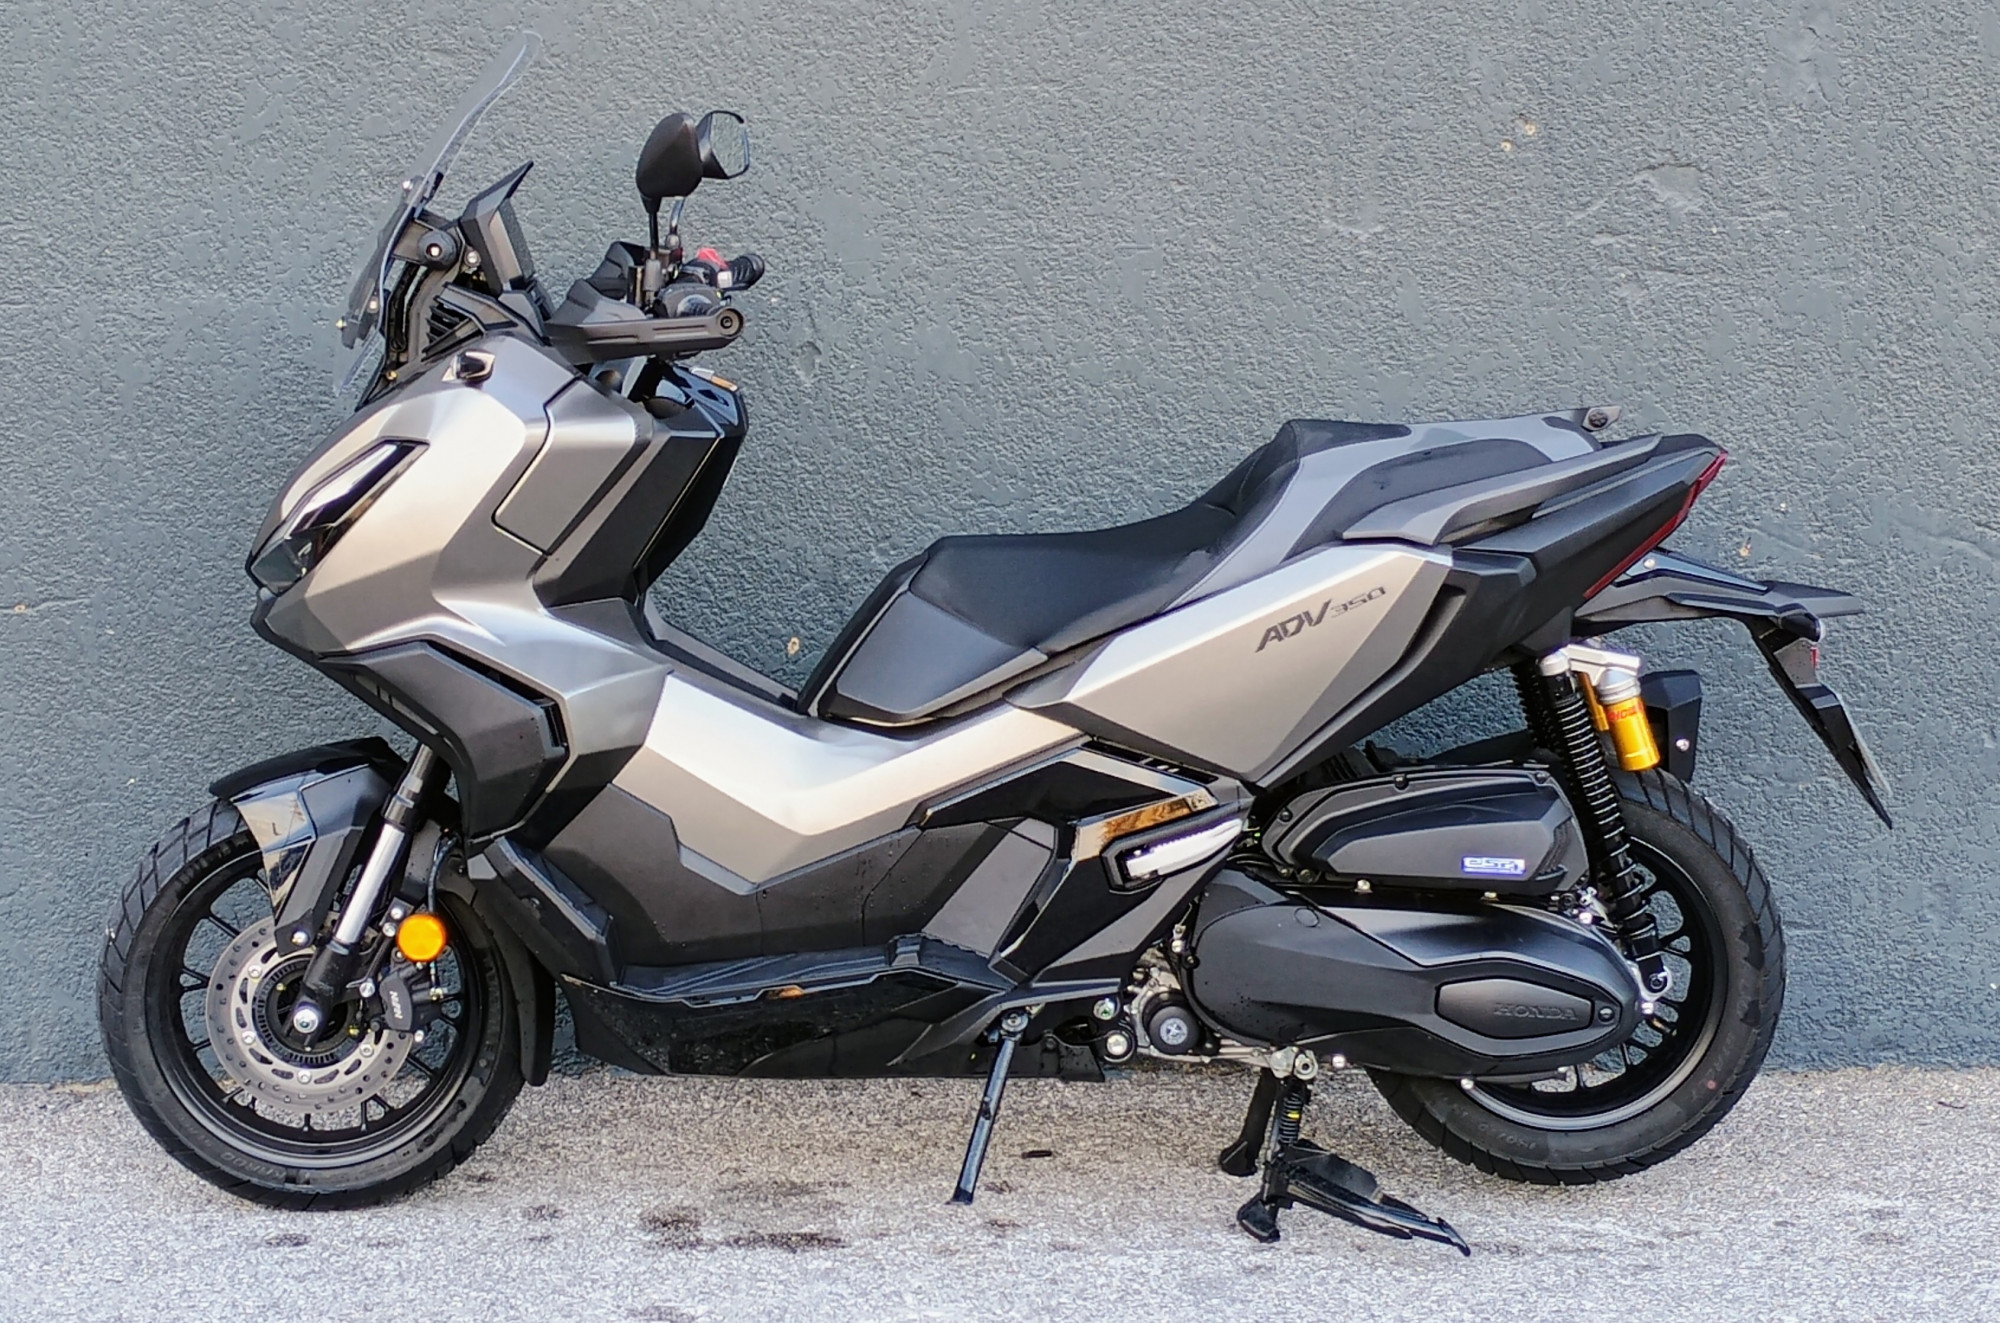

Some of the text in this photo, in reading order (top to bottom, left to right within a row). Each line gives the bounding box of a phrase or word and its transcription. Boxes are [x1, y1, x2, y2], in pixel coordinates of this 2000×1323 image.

[1255, 586, 1386, 653] ADV 350
[1494, 1002, 1578, 1020] HONDA
